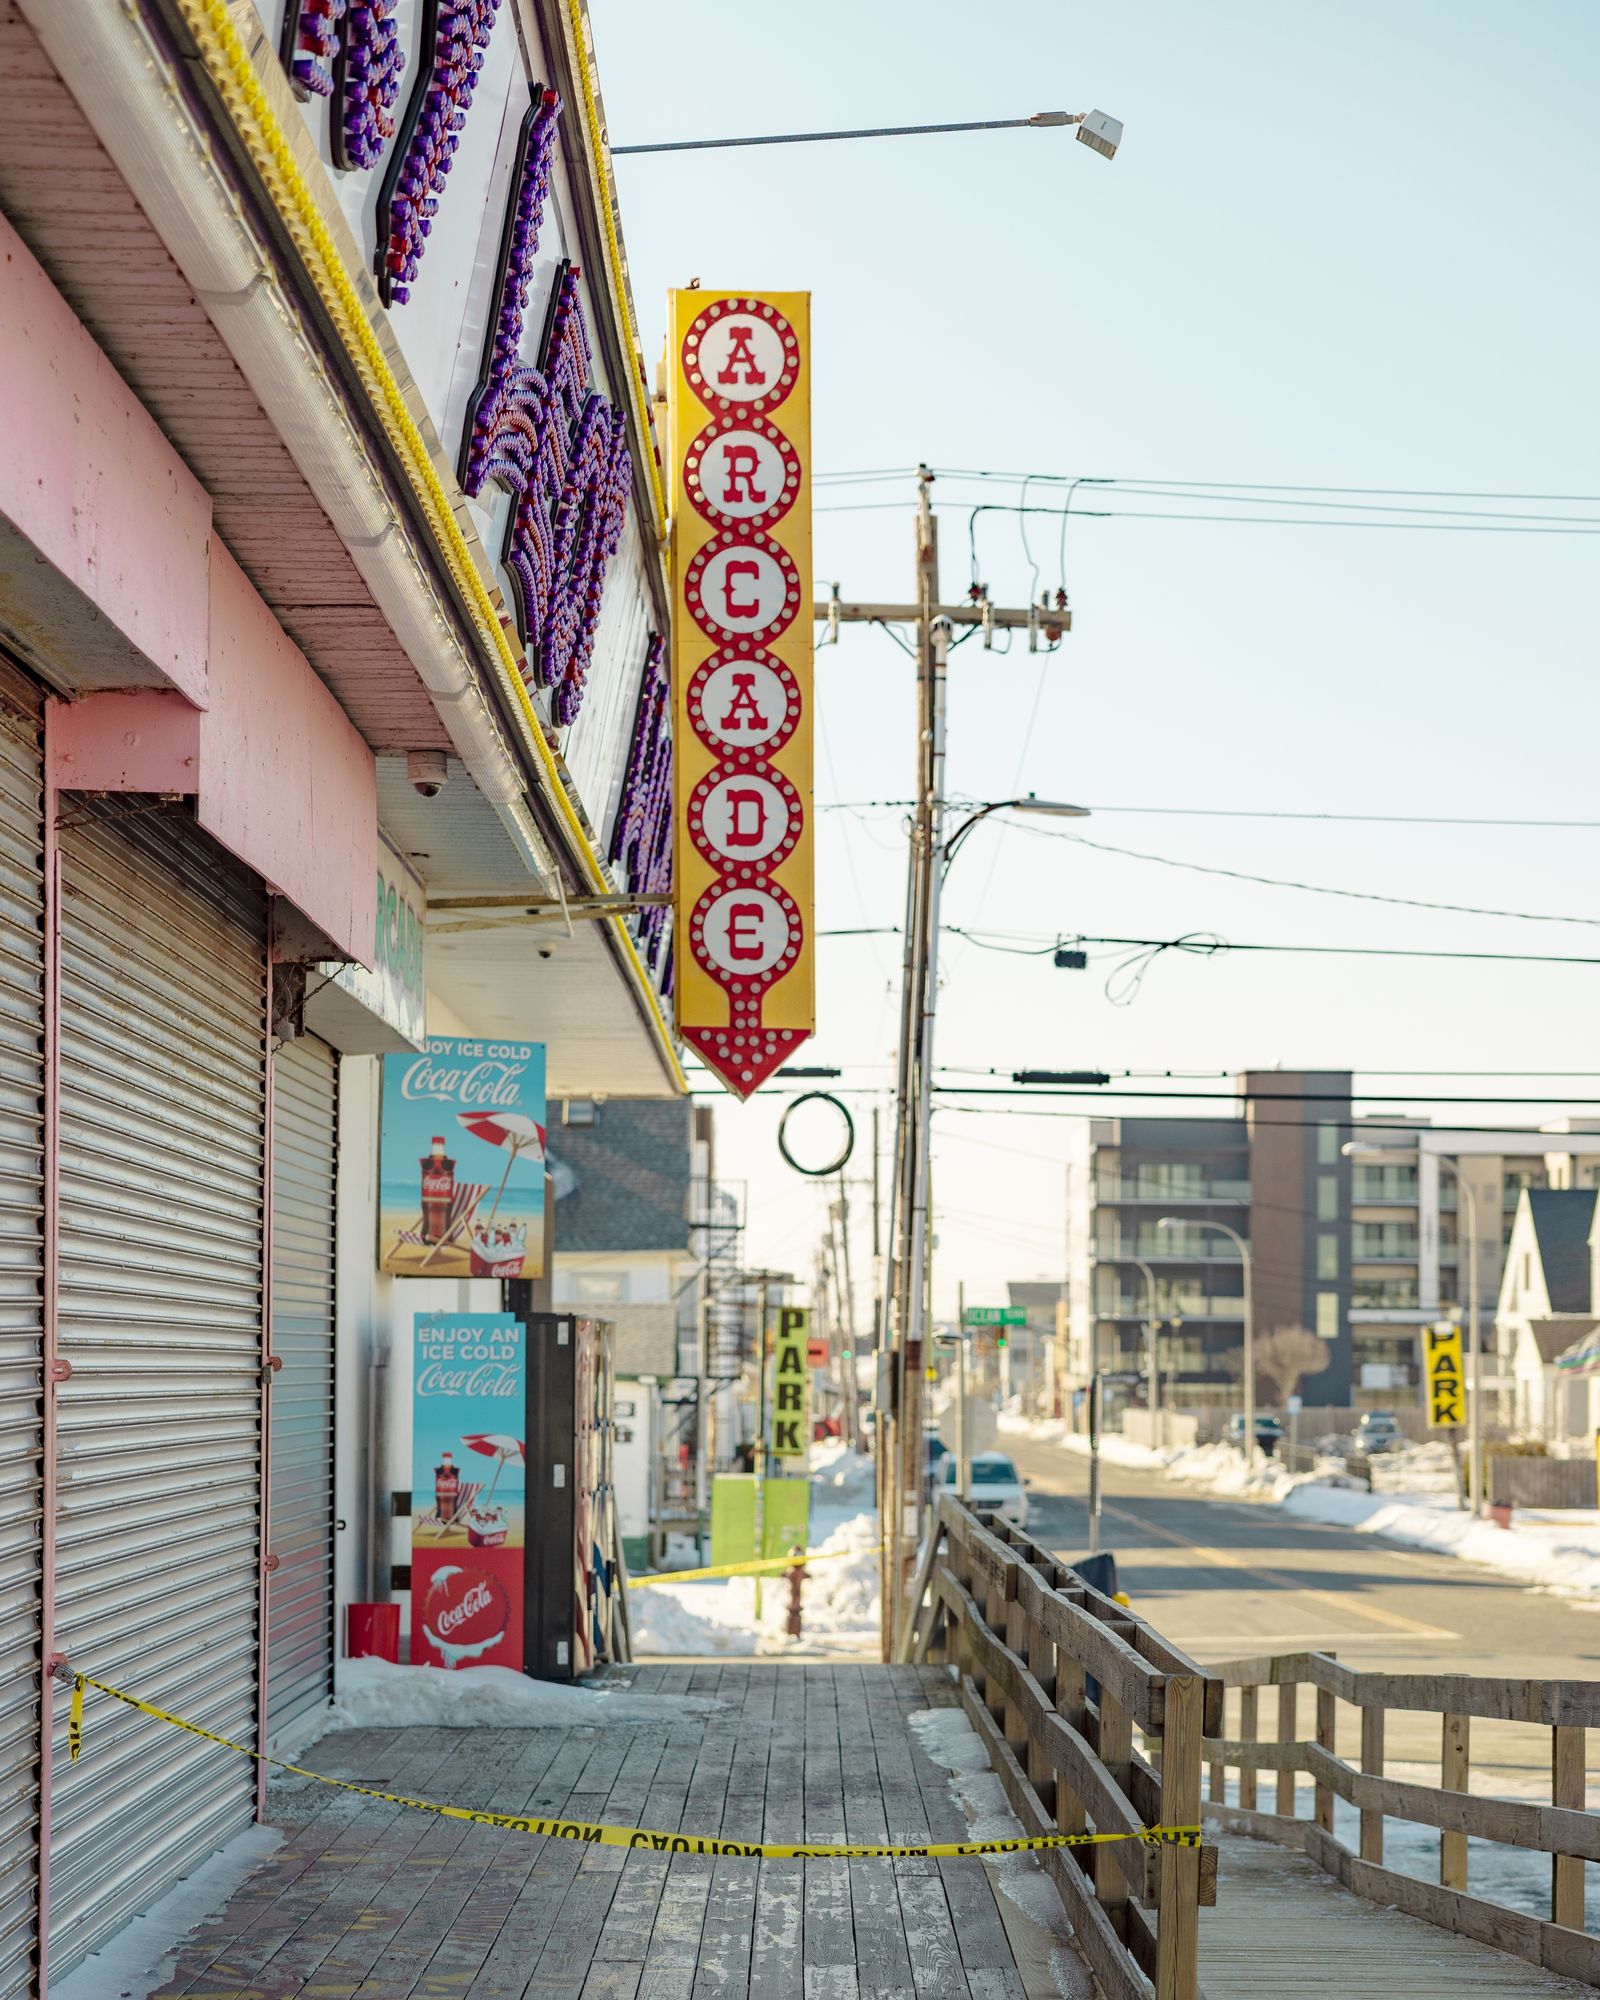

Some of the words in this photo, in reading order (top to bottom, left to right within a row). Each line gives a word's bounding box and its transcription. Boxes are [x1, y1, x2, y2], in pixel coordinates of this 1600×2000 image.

[717, 326, 768, 961] ARCADE
[374, 868, 424, 1003] RCADE
[457, 1043, 484, 1058] ICE
[487, 1045, 532, 1060] COLD
[418, 1328, 484, 1343] ENJOY
[490, 1328, 520, 1343] AN
[422, 1345, 456, 1361] ICE
[461, 1345, 516, 1361] COLD
[776, 1311, 804, 1449] PARK
